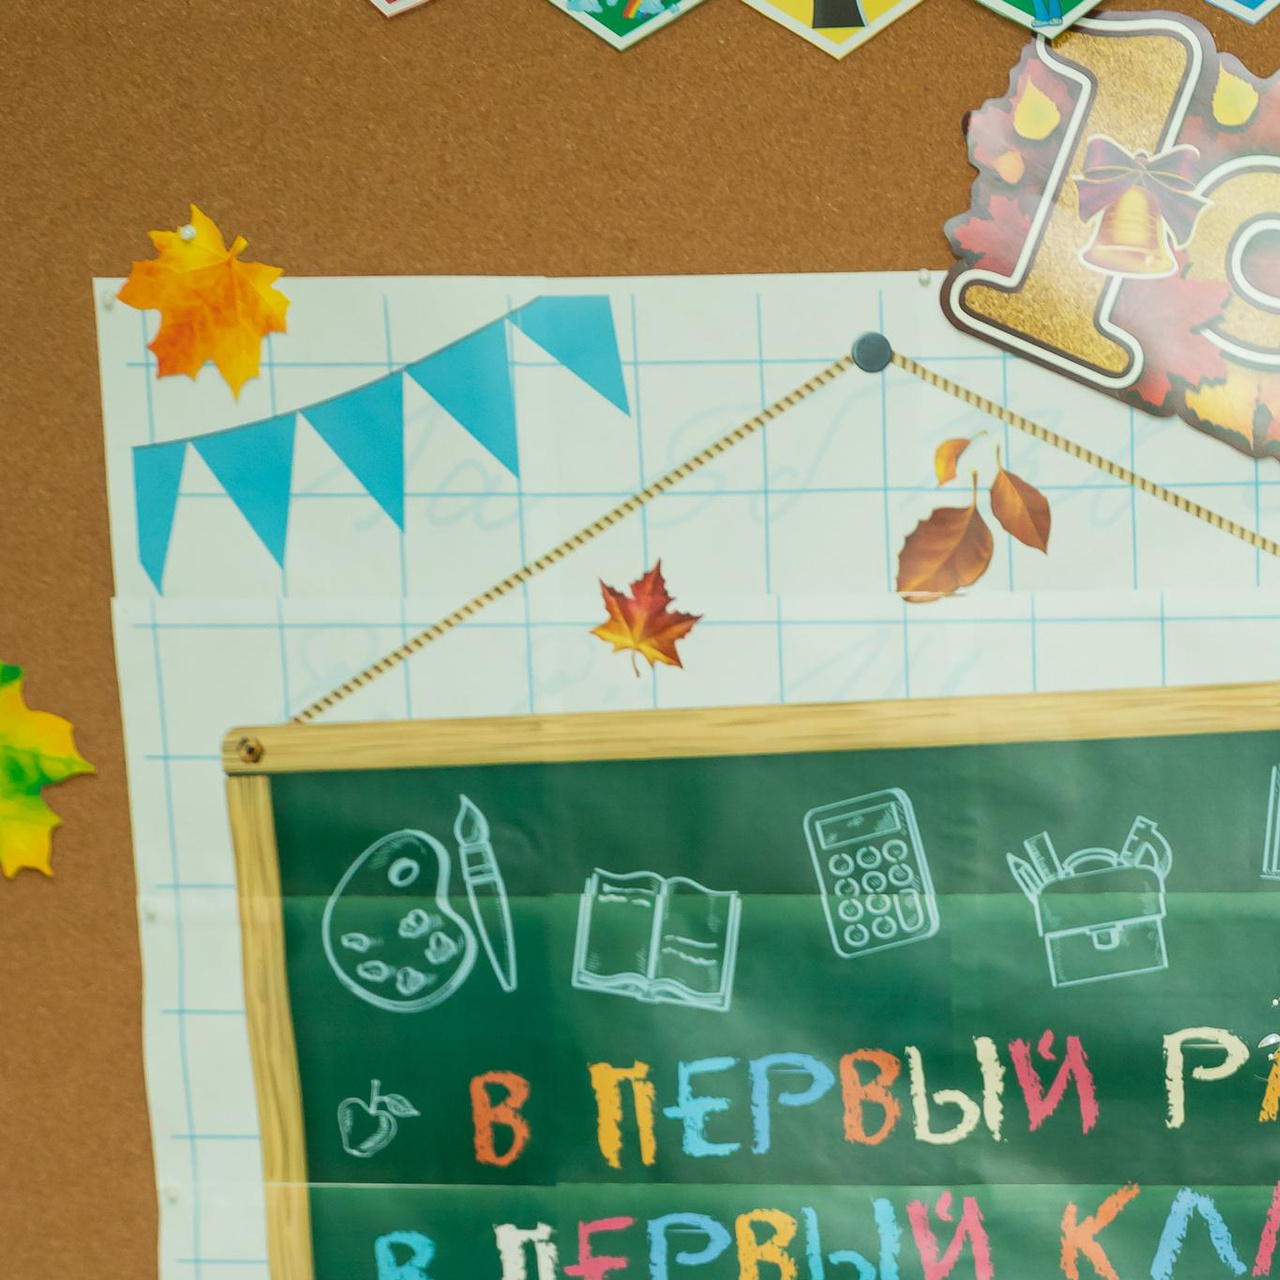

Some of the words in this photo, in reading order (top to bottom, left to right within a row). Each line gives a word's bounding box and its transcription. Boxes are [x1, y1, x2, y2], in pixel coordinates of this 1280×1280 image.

[952, 18, 1203, 390] 1
[469, 1070, 532, 1168] В
[588, 1029, 1099, 1169] ПЕРВЫЙ
